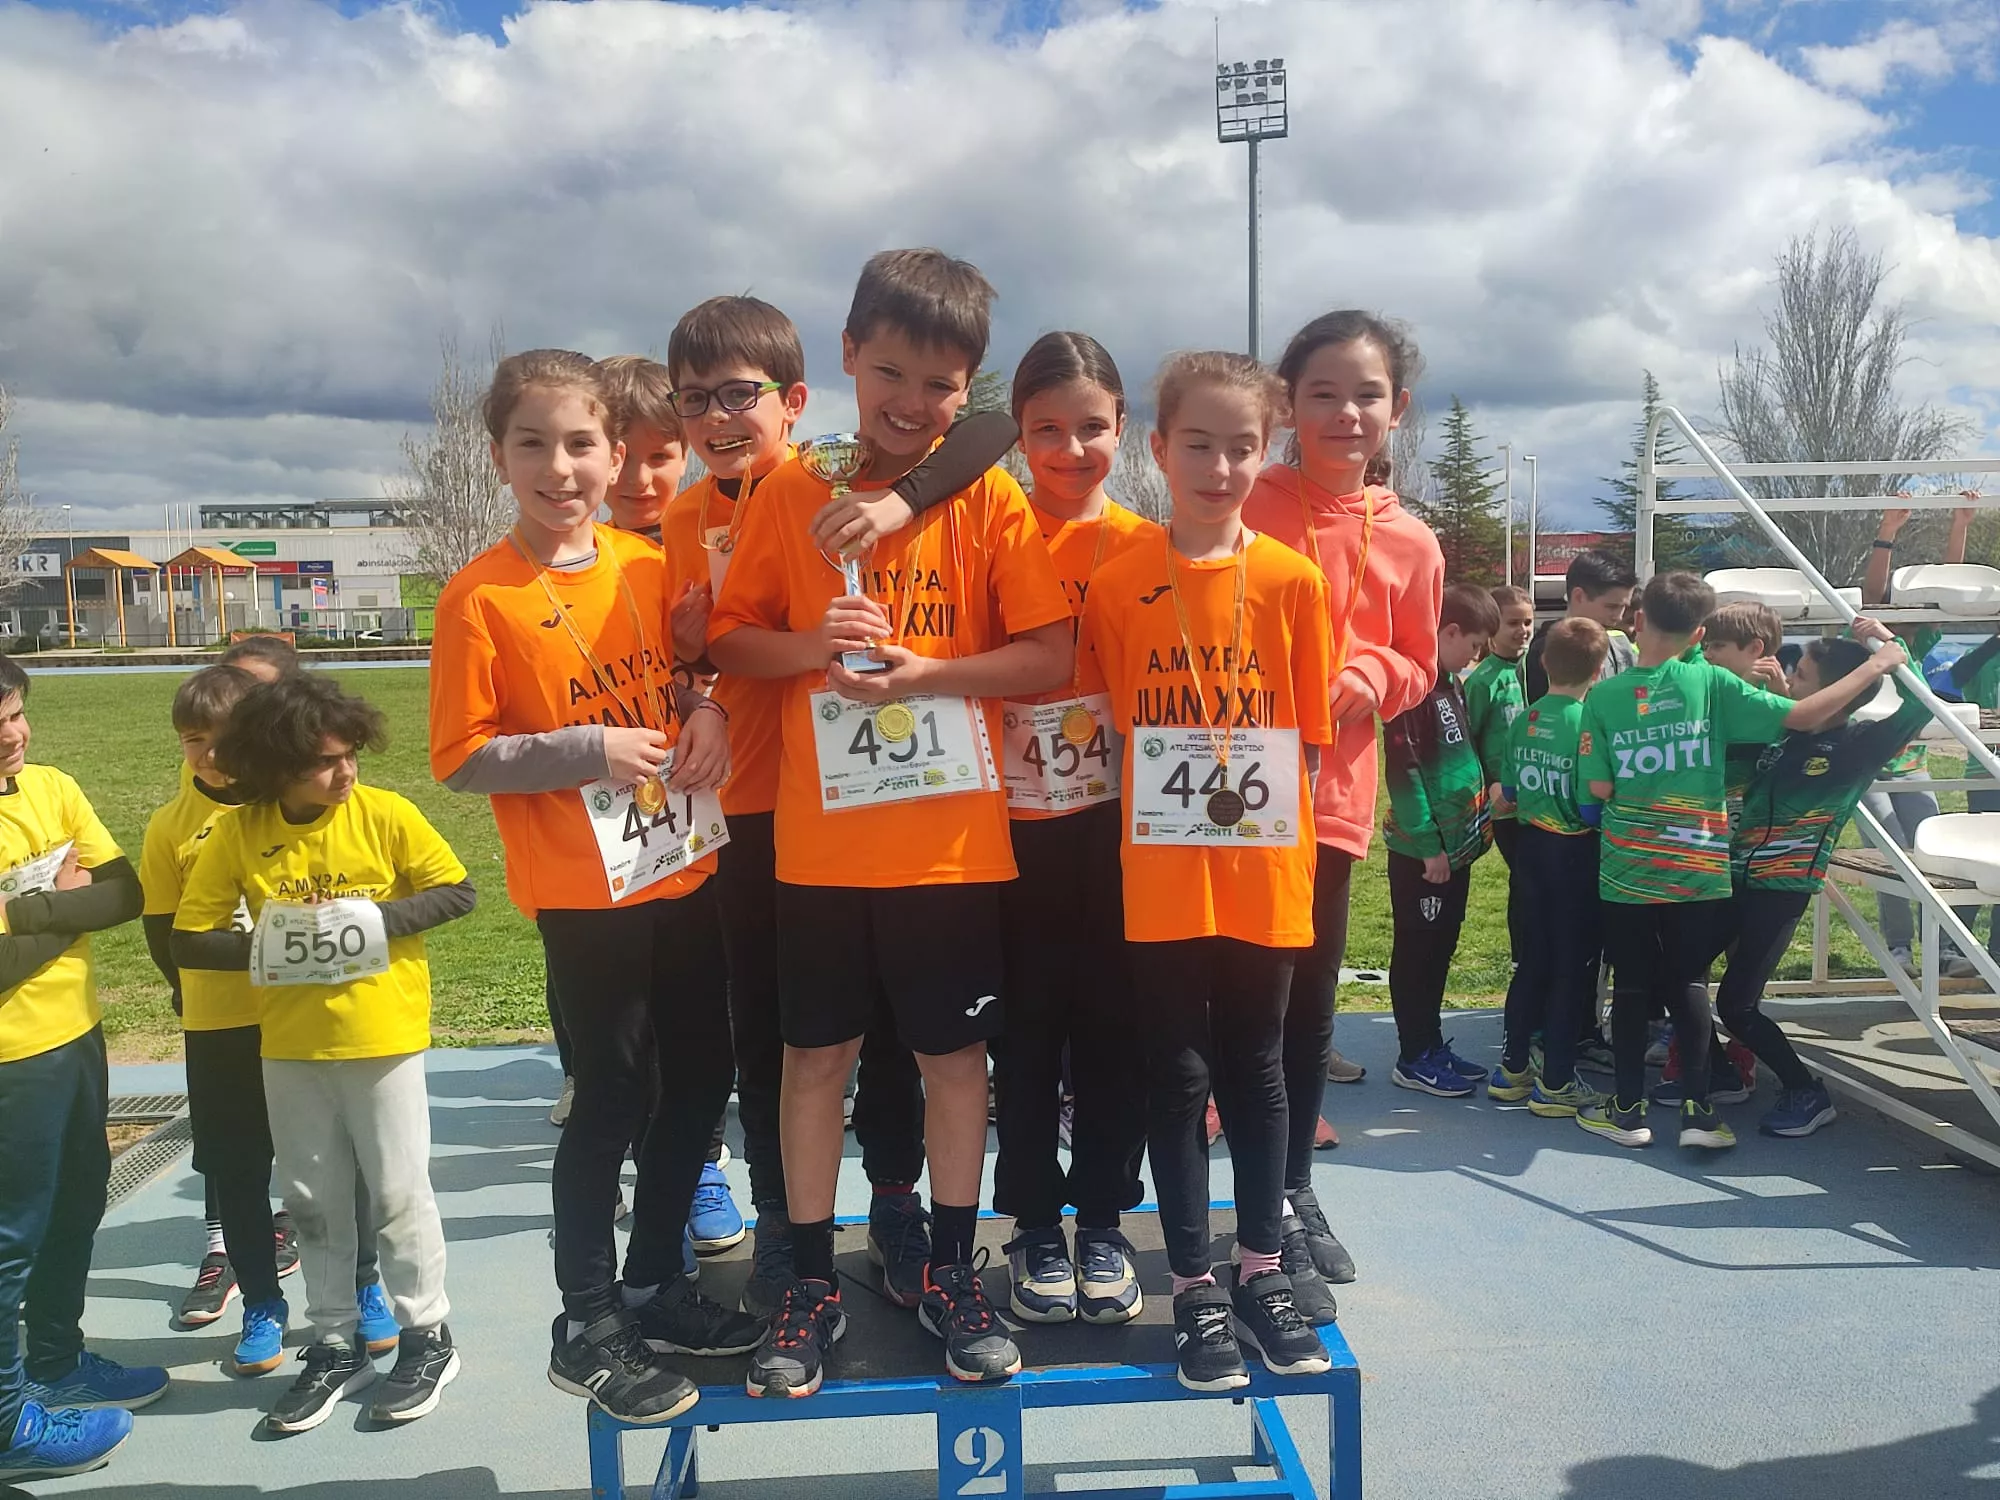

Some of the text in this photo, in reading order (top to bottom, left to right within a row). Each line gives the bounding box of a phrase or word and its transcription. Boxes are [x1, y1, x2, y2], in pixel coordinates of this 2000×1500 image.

[1132, 685, 1275, 729] JUAN XXIII
[1440, 709, 1457, 726] es
[1022, 724, 1111, 778] 454
[1215, 733, 1247, 741] TONEO
[1219, 744, 1264, 752] DVERTIDO
[1445, 727, 1463, 744] ca
[1612, 719, 1711, 746] ATLETISMO
[1615, 736, 1712, 778] ZOITI
[1160, 760, 1270, 811] 446
[1515, 765, 1571, 799] OITI
[285, 924, 366, 965] 550
[953, 1426, 1007, 1496] 2
